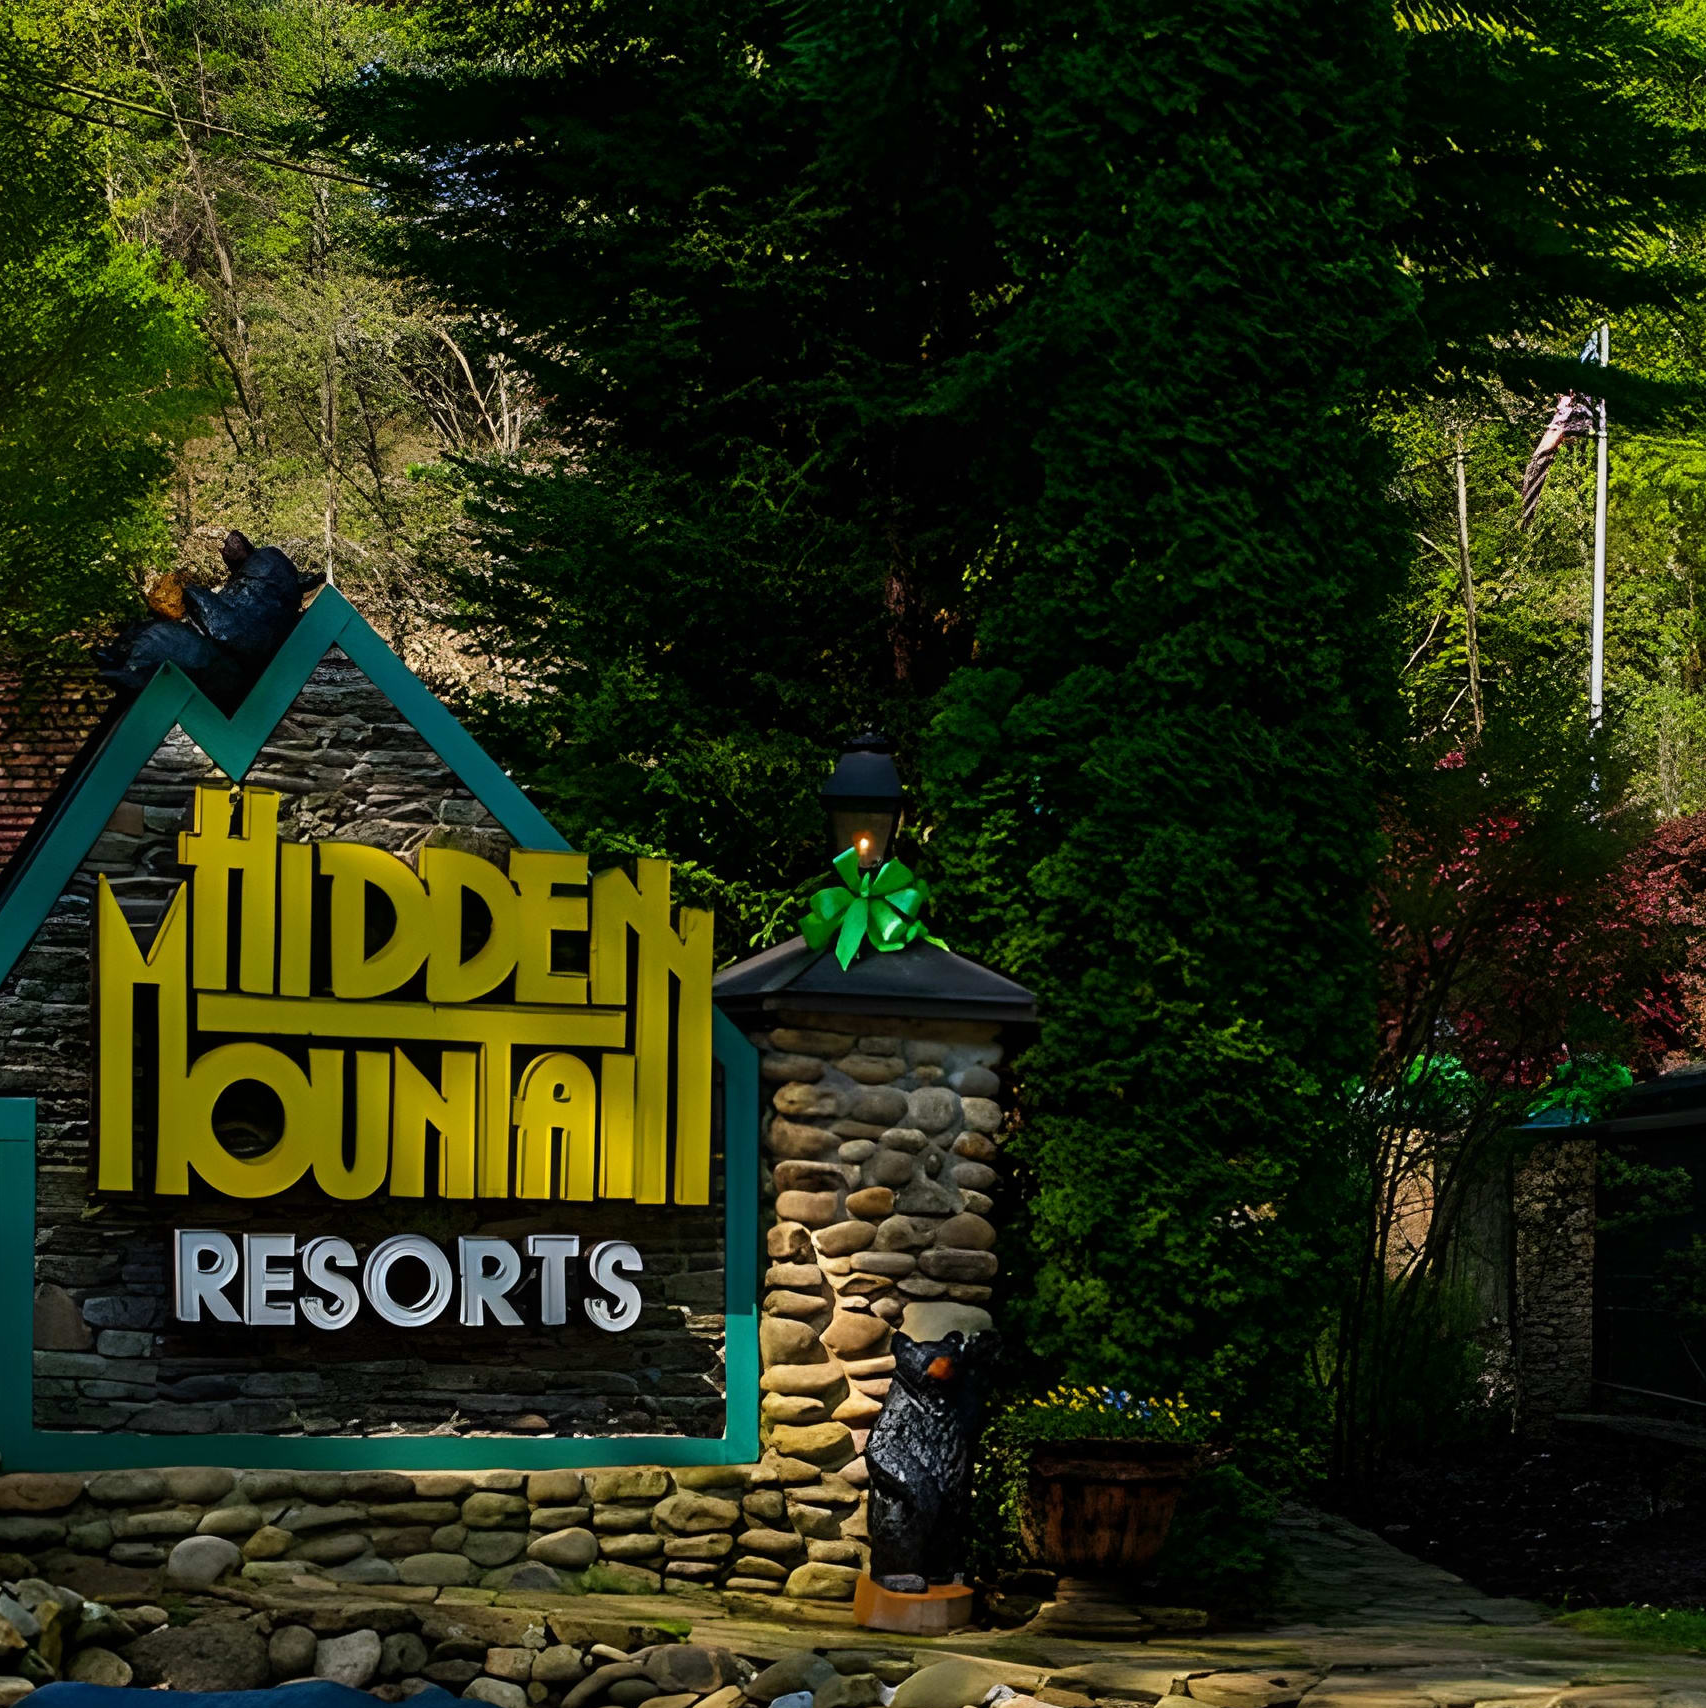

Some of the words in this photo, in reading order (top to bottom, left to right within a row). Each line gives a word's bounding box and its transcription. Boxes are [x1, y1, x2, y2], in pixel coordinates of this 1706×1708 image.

[178, 785, 672, 1006] HIDDEN
[97, 872, 714, 1205] MOUNTAIN
[174, 1228, 643, 1332] RESORTS
